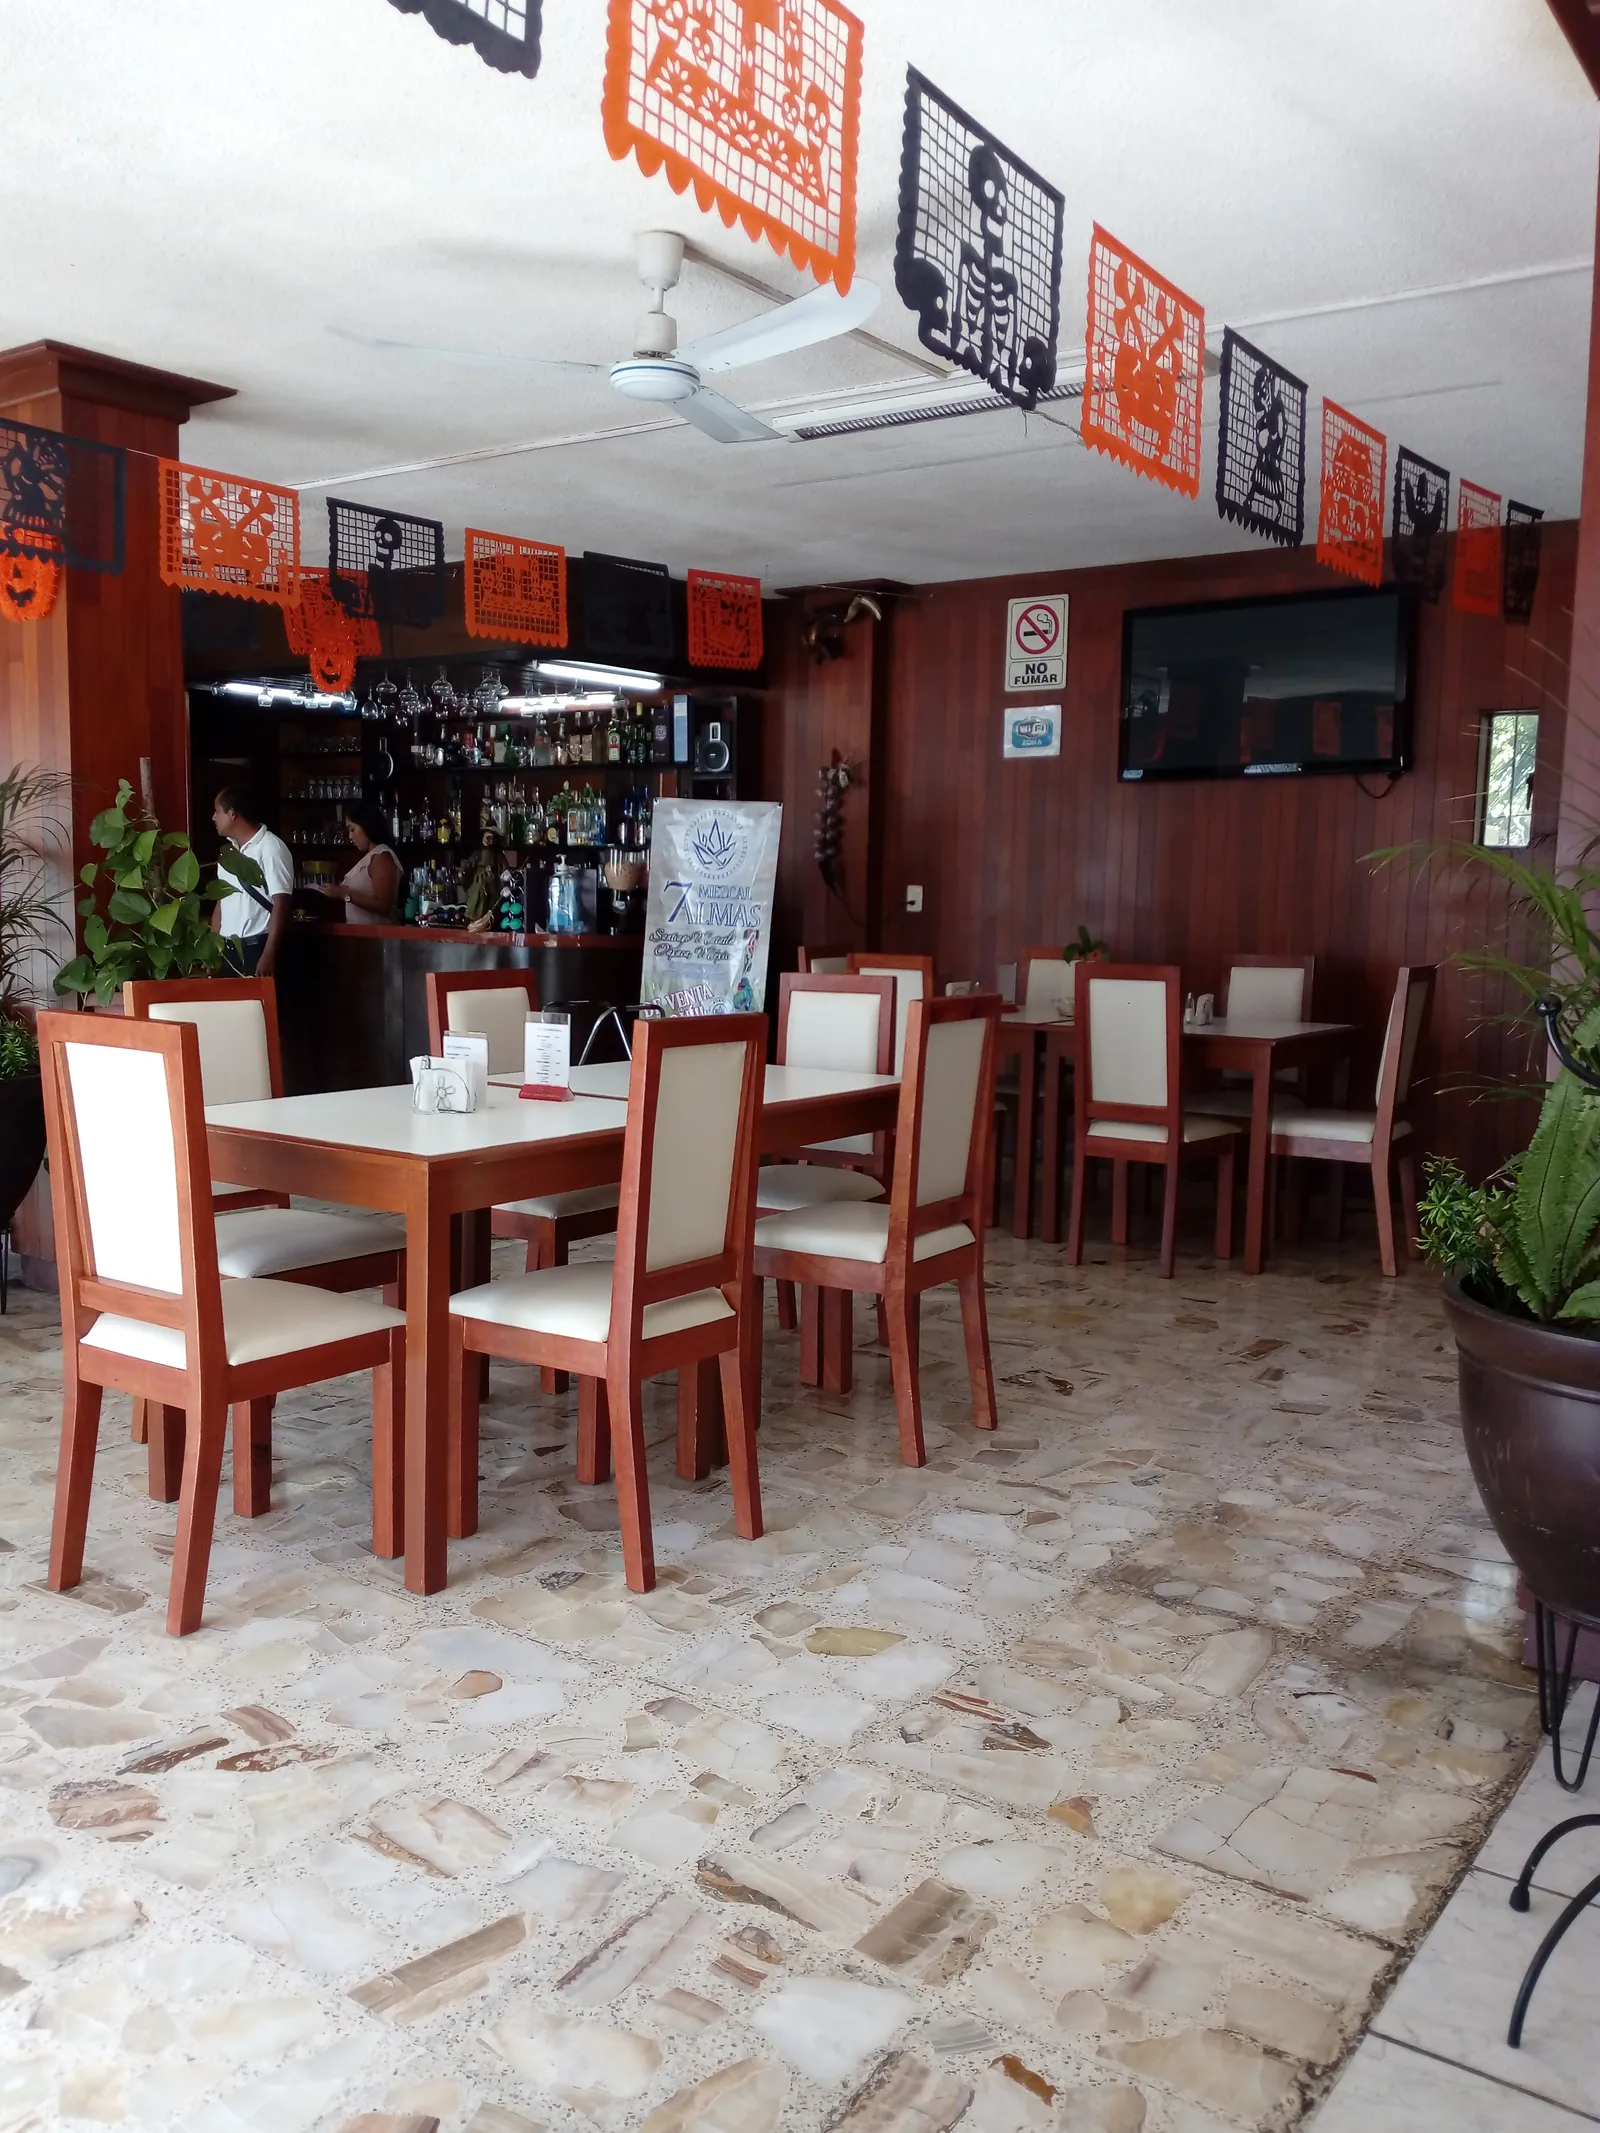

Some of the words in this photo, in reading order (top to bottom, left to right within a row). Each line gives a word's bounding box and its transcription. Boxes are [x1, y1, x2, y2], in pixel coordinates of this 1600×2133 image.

[1025, 662, 1048, 675] NO
[1014, 673, 1058, 685] FUMAR
[698, 884, 753, 900] MEZCAL
[663, 880, 693, 923] 7
[682, 899, 762, 928] ALMAS
[663, 983, 715, 1010] VENTA
